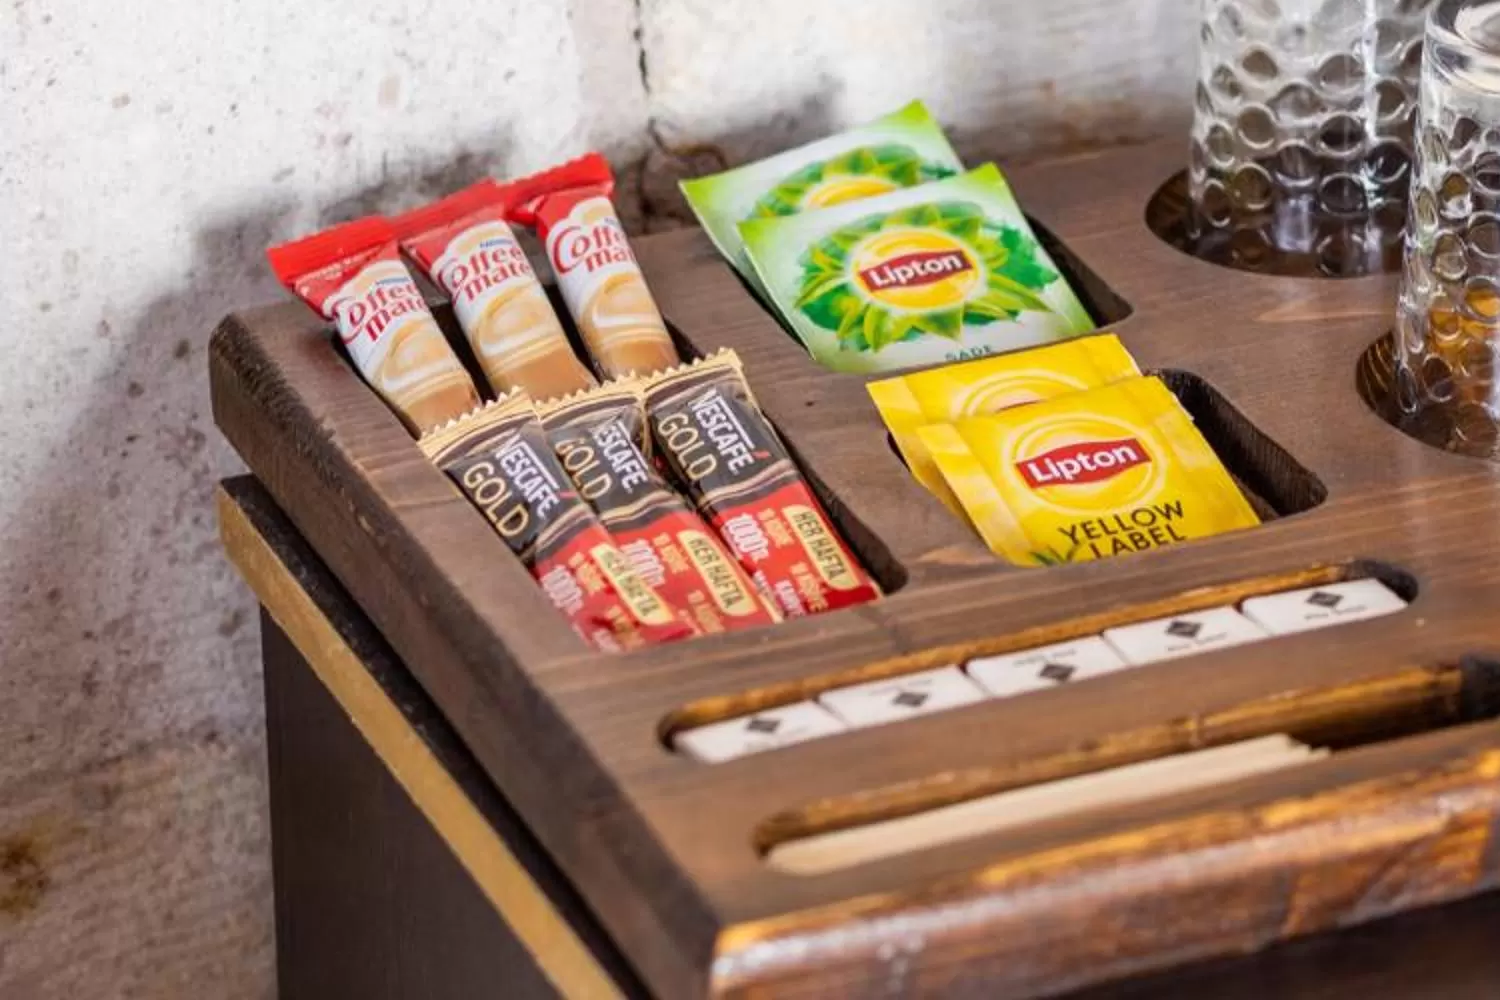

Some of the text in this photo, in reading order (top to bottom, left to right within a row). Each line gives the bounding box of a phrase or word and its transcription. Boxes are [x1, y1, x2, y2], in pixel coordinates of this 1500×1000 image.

[868, 252, 963, 289] Lipton
[555, 438, 612, 499] GOLD
[658, 412, 717, 480] GOLD
[1027, 445, 1140, 483] Lipton
[463, 462, 529, 536] GOLD
[1058, 500, 1184, 546] YELLOW
[1088, 523, 1187, 560] LABEL
